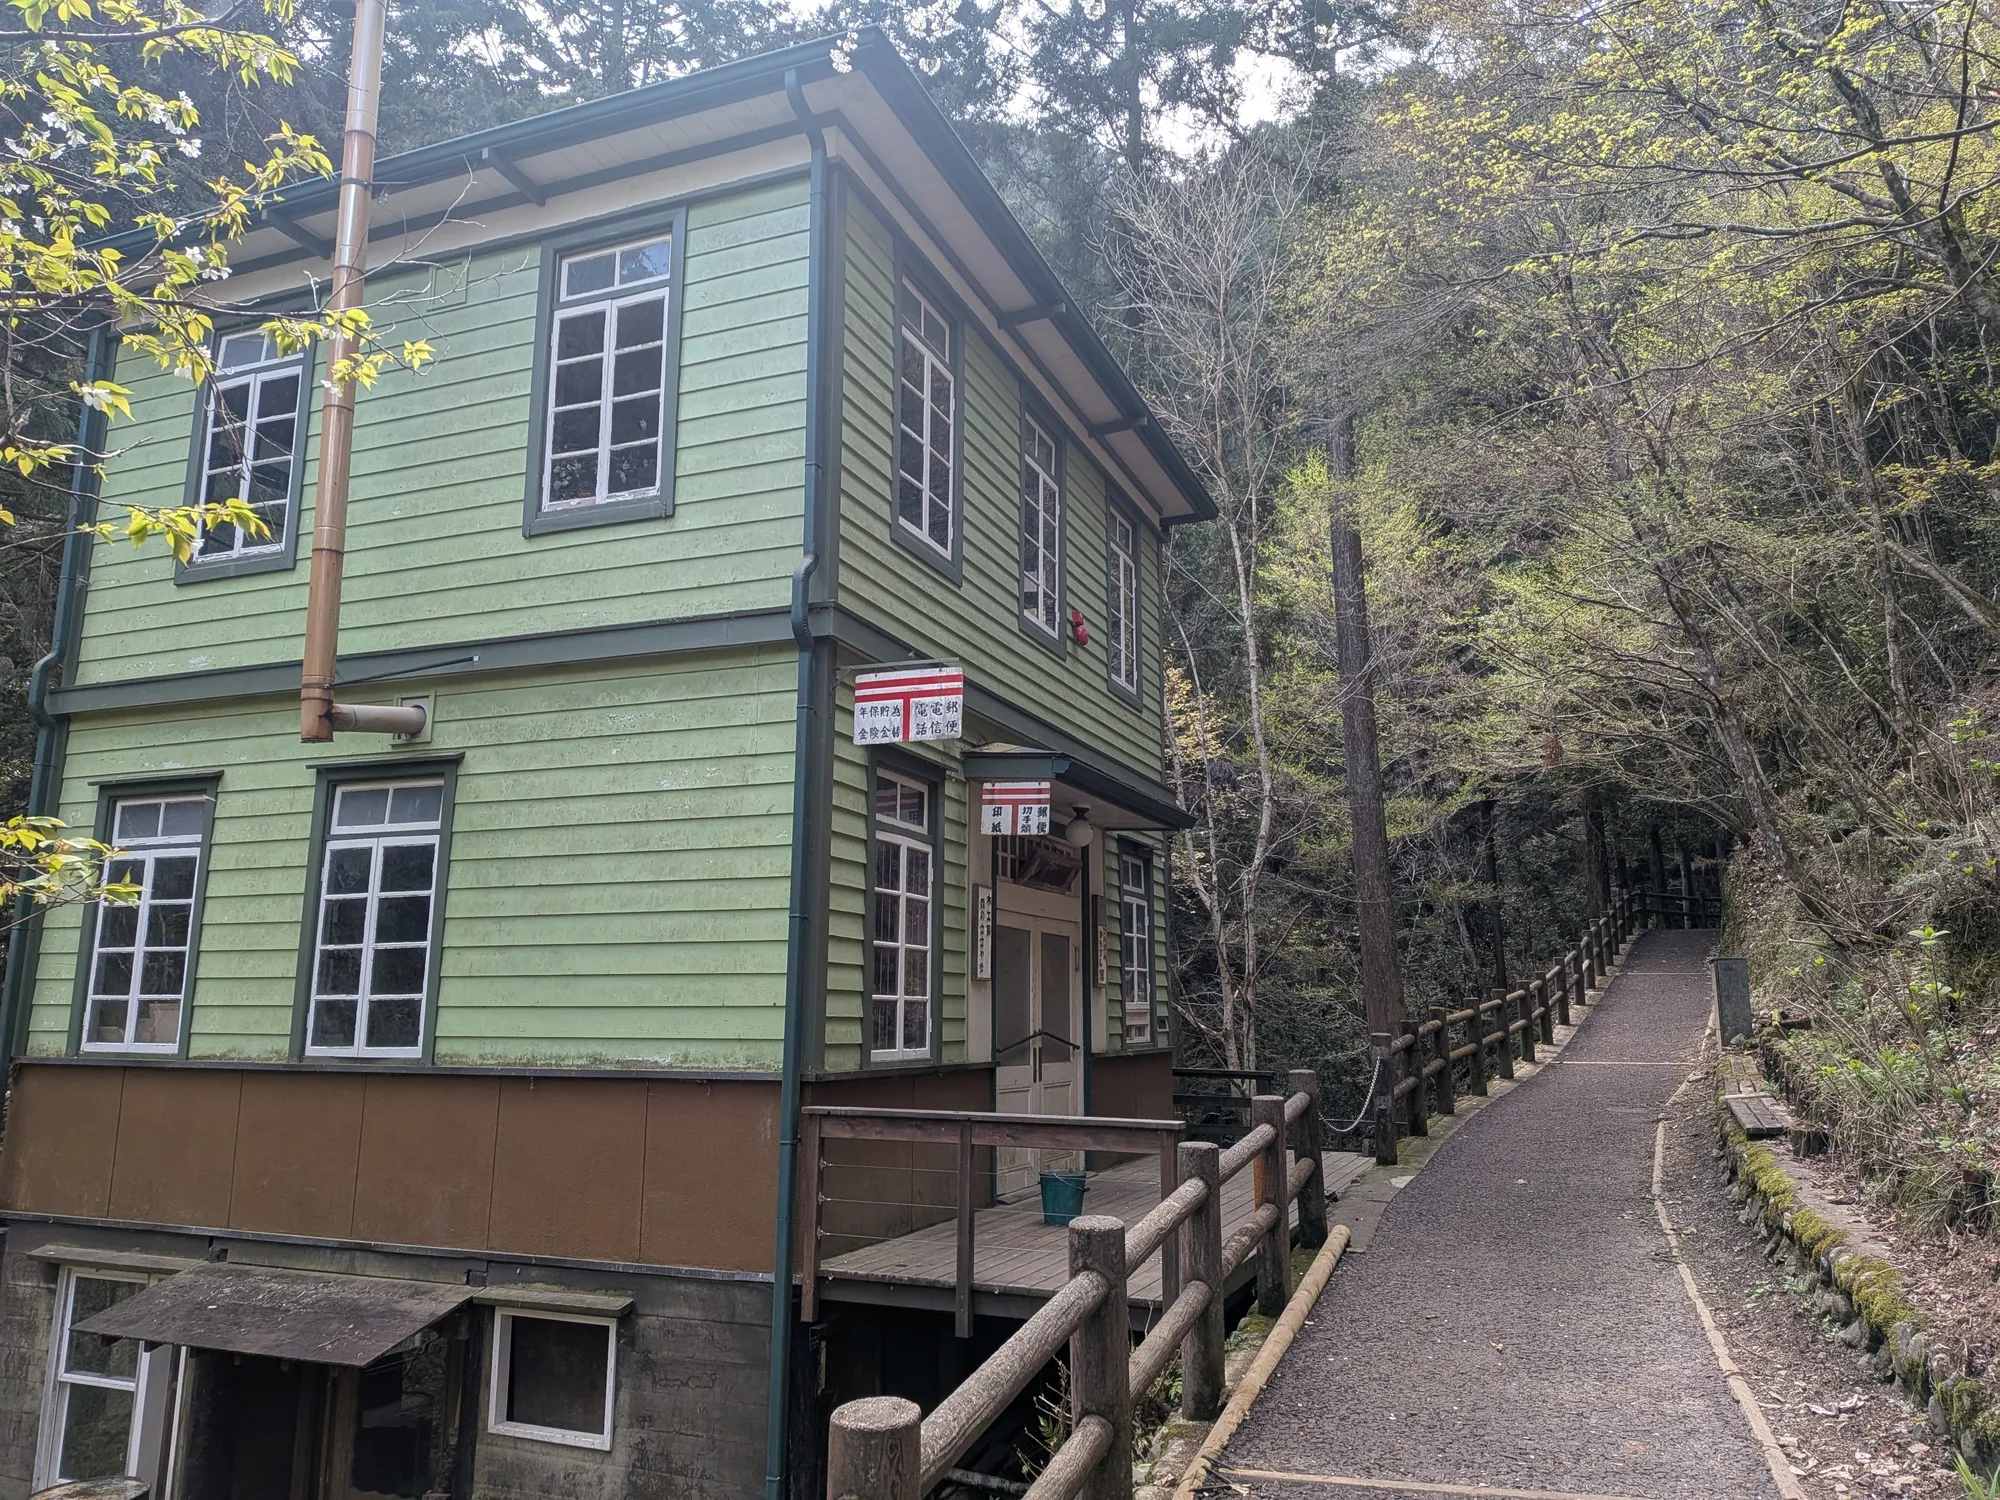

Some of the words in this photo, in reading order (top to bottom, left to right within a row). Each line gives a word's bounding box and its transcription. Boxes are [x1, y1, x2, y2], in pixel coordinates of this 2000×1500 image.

[858, 707, 868, 740] 年金
[880, 706, 891, 739] 貯金
[915, 703, 928, 736] 電話
[929, 702, 943, 735] 電信
[945, 701, 959, 733] 郵便
[991, 806, 1002, 833] 印紙
[1036, 806, 1048, 833] 郵便
